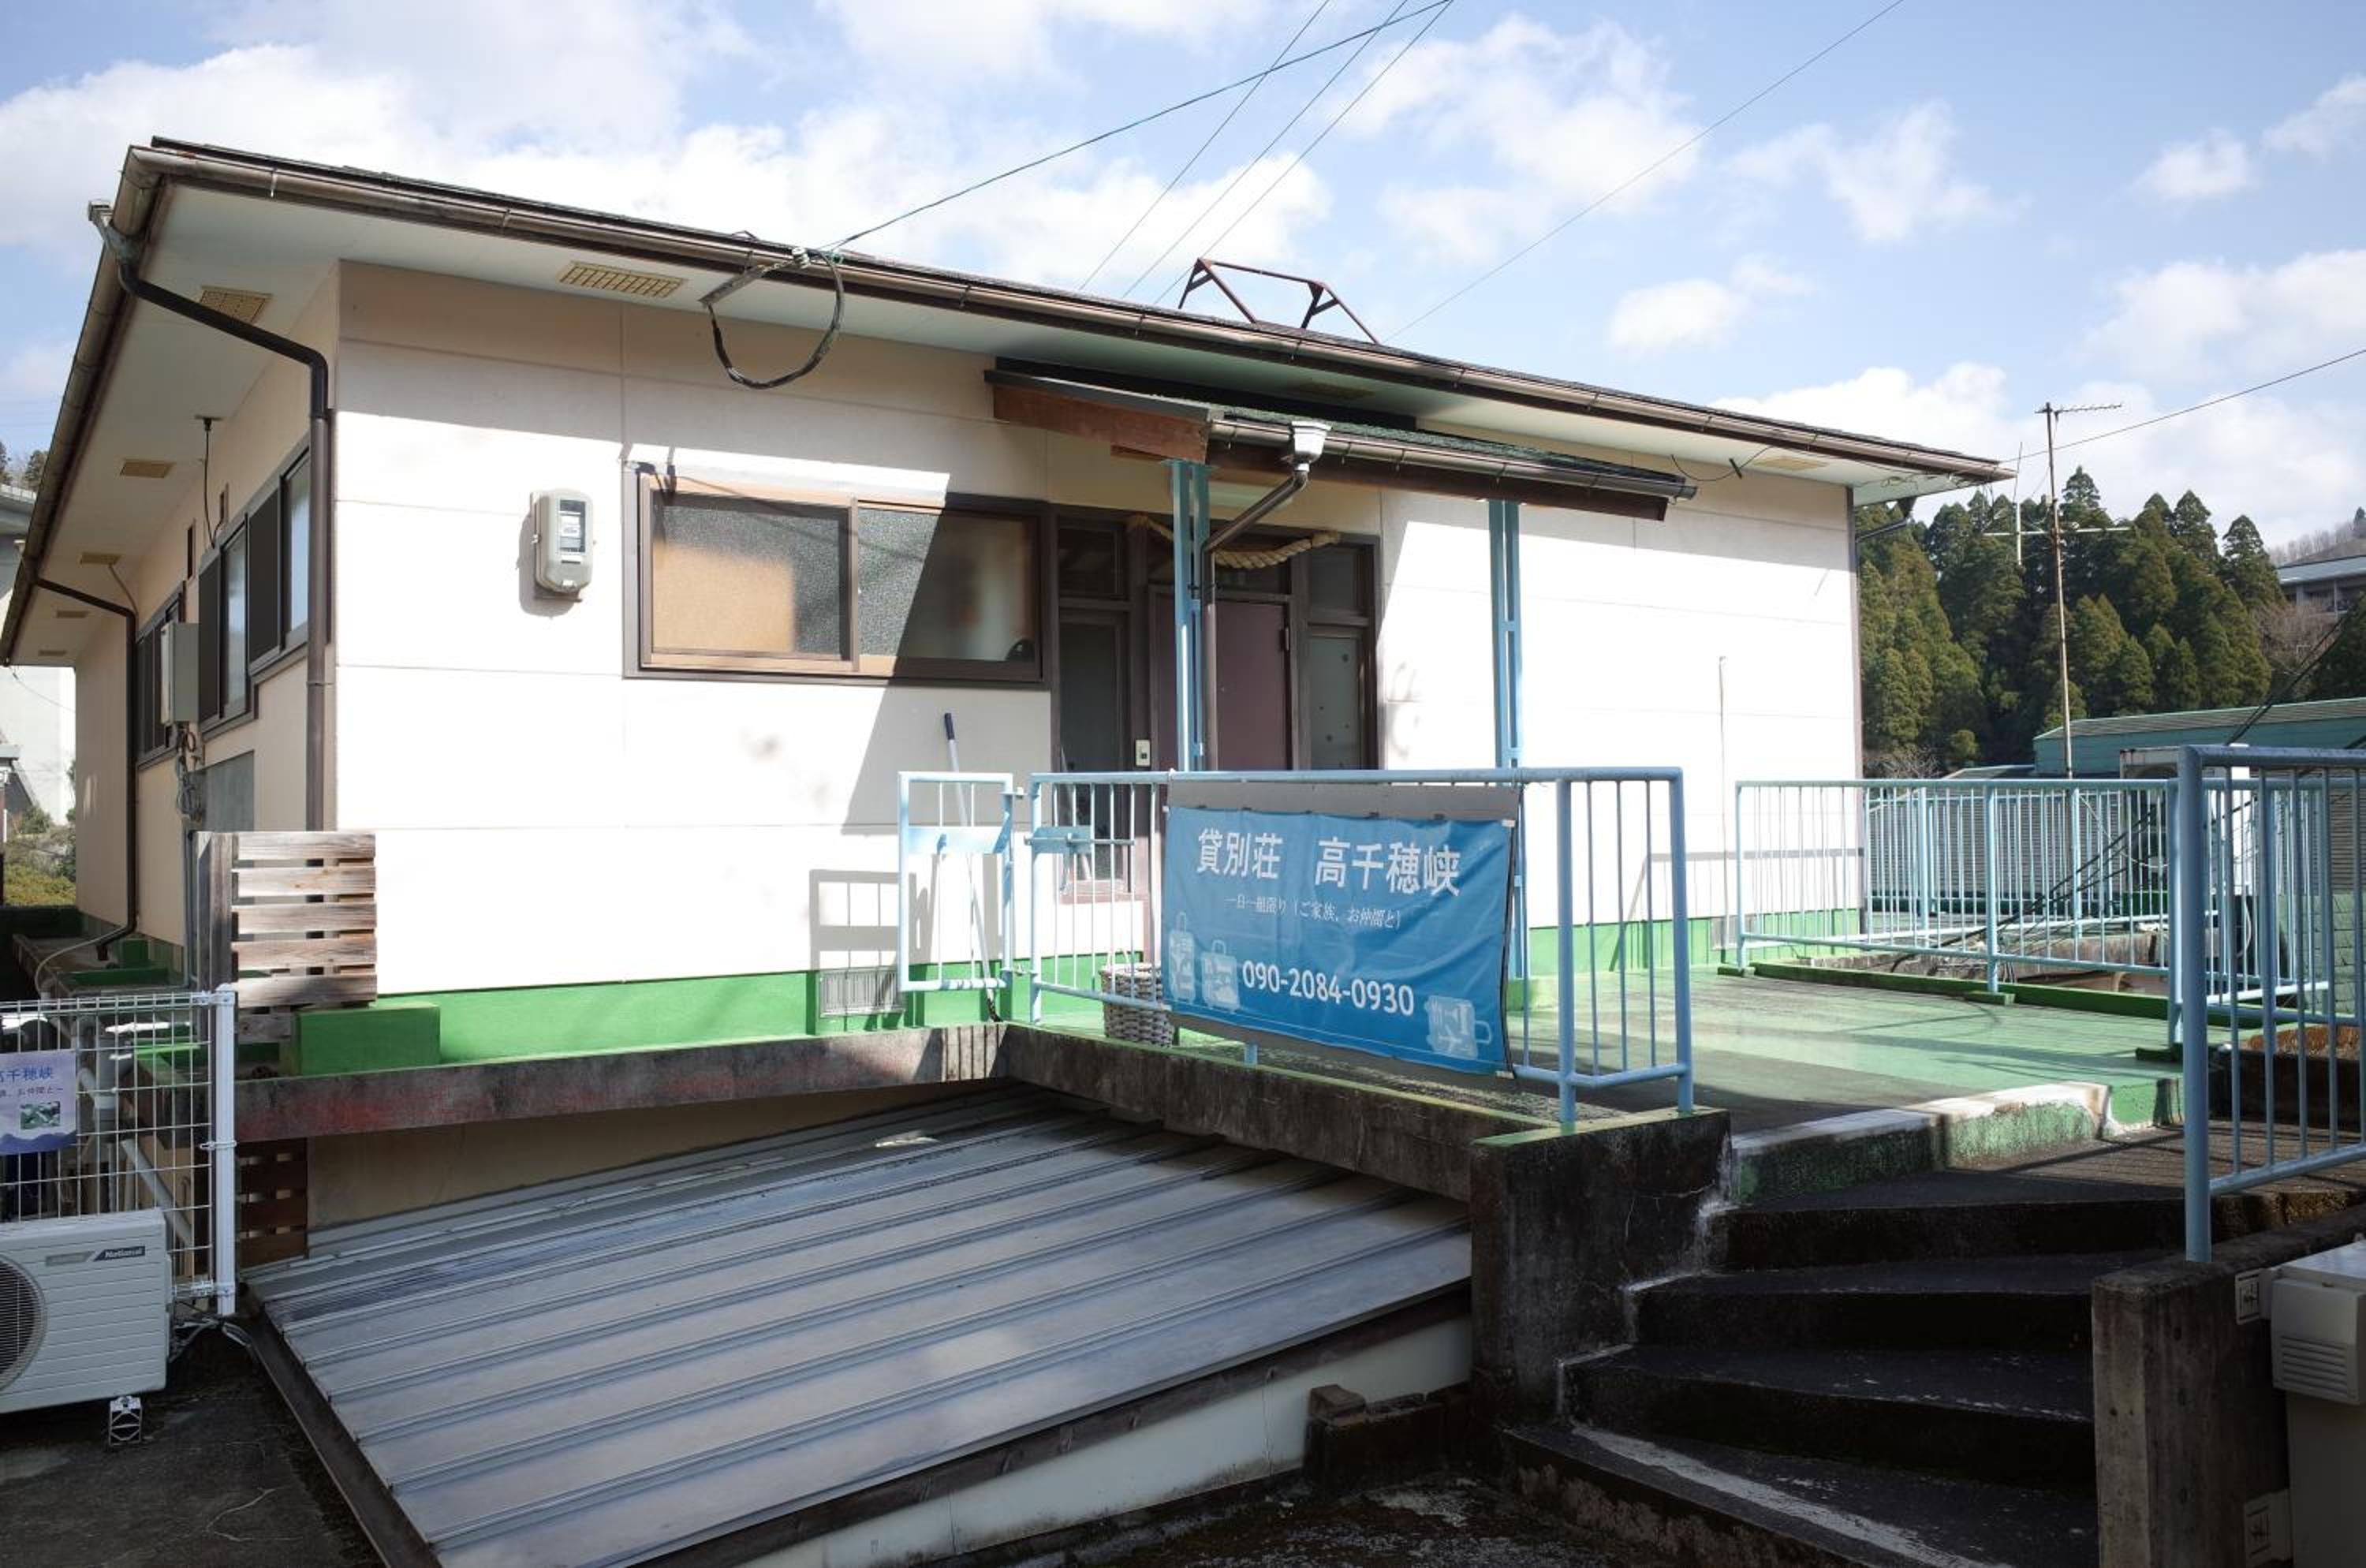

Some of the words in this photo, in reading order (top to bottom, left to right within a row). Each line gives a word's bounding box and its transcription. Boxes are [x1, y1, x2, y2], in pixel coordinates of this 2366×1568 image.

[1196, 827, 1282, 879] 貸別荘
[1315, 836, 1461, 897] 高千穂峡
[1243, 960, 1414, 1017] 090-2084-0930
